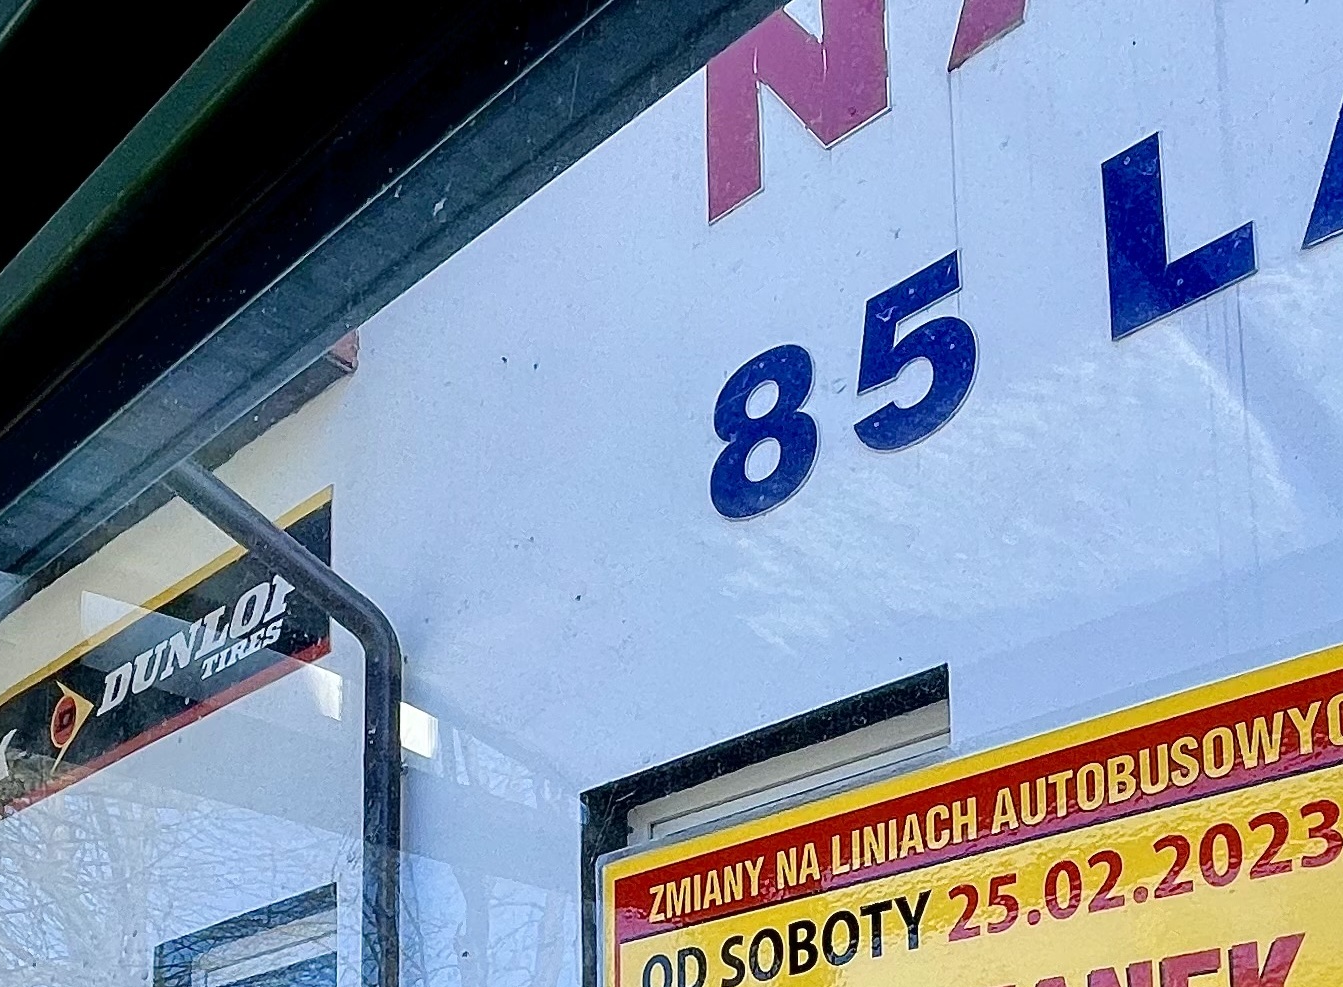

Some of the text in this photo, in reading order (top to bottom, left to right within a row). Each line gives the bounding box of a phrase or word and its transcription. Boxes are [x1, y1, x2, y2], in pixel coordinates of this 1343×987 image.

[707, 0, 1026, 225] N
[709, 250, 981, 523] 85
[200, 618, 284, 681] TIRES
[647, 857, 765, 923] ZMIANY
[774, 846, 822, 889] NA
[832, 796, 977, 874] LINIACH
